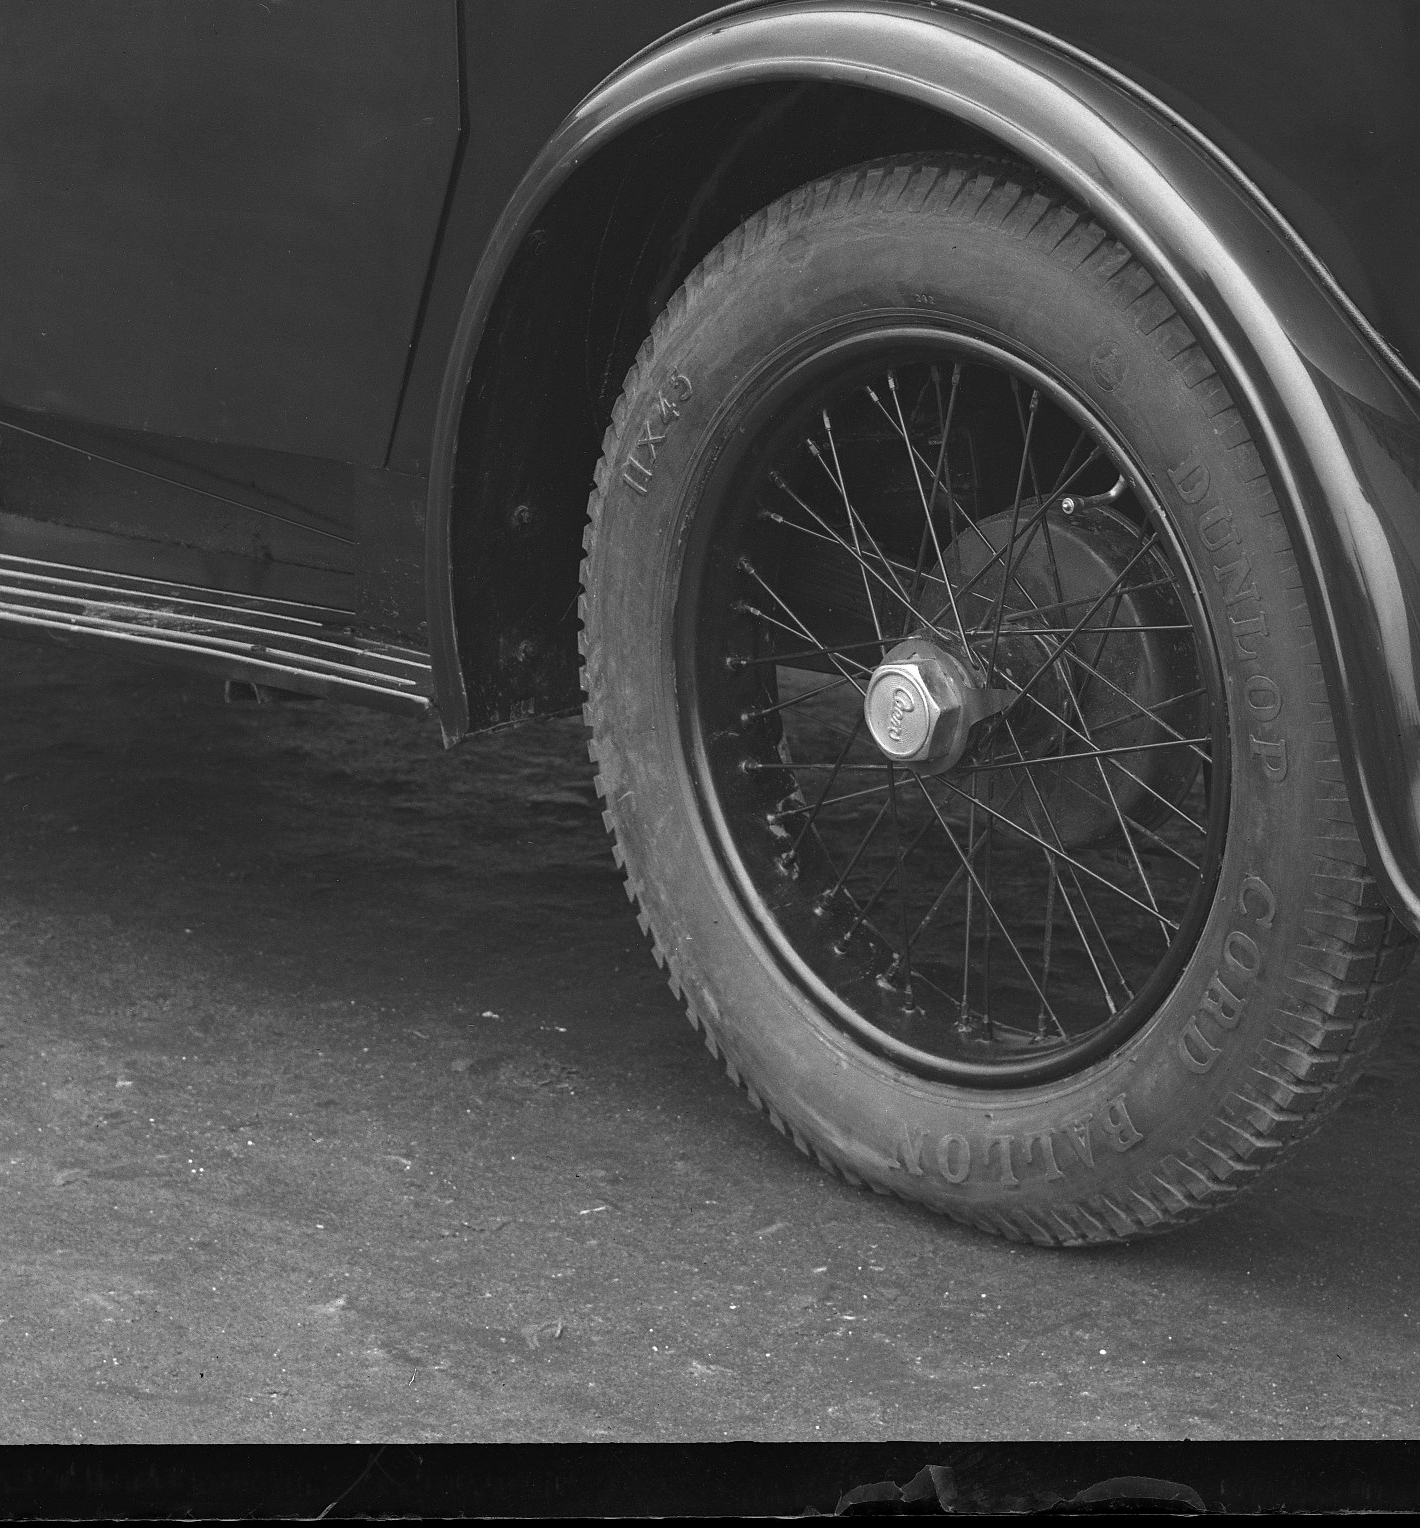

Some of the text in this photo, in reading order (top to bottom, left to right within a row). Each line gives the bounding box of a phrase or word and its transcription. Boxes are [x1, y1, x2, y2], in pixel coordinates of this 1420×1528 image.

[888, 454, 1290, 1190] DUNLOP CORD BALLON
